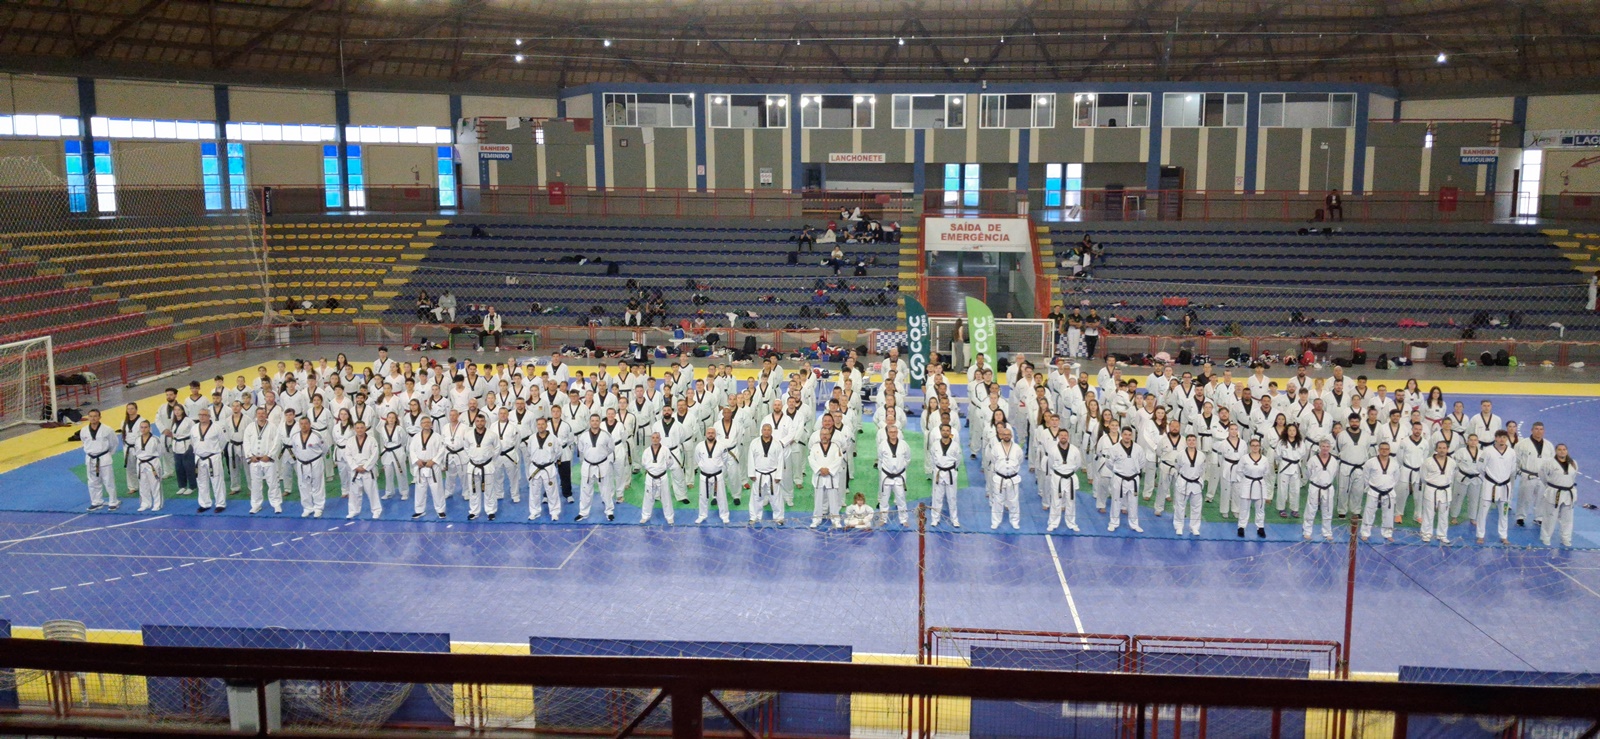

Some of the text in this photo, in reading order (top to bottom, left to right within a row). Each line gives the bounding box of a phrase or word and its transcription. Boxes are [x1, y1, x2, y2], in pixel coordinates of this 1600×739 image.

[1575, 136, 1600, 145] LAG
[831, 154, 883, 162] LANCHONETE
[950, 222, 1002, 232] SAÍDA DE
[940, 232, 1011, 242] EMERGÊNCIA
[920, 314, 928, 337] Lages
[987, 315, 995, 337] Lages
[909, 315, 923, 353] COC
